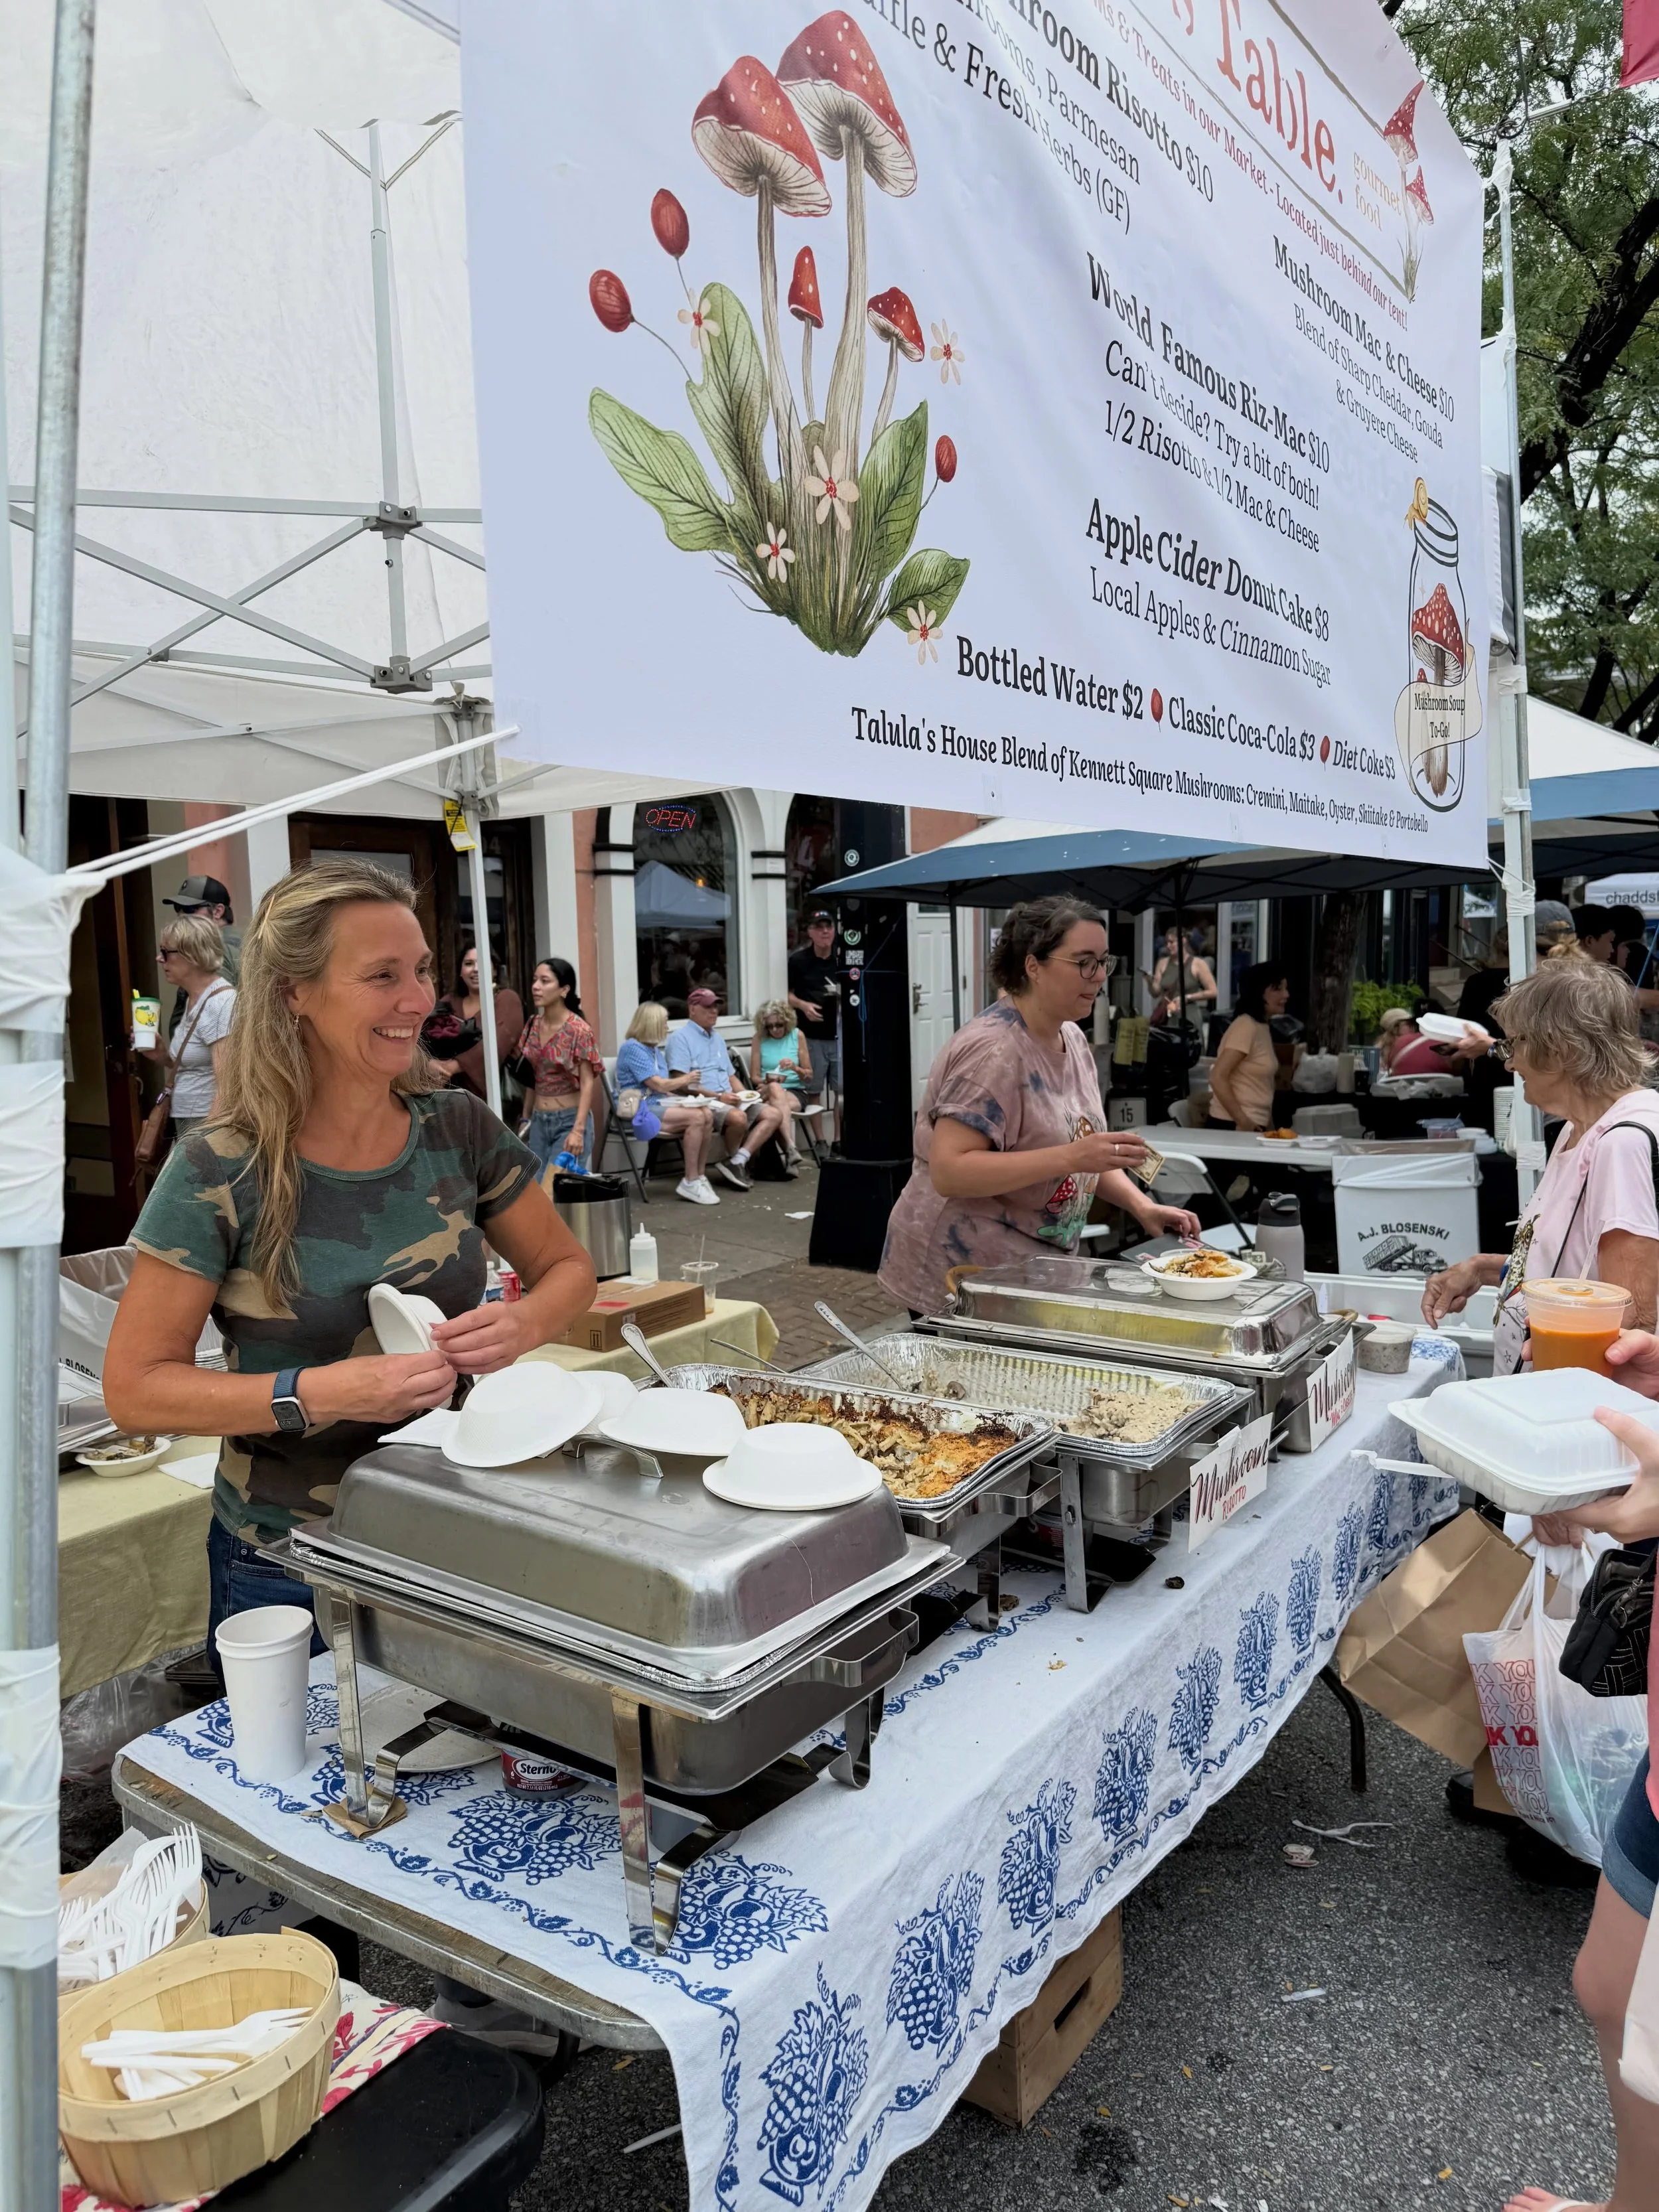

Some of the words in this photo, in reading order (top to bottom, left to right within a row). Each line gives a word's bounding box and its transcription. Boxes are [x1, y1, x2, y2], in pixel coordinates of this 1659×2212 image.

[934, 23, 956, 73] &
[964, 42, 1037, 133] Fresh
[1036, 110, 1092, 195] Herbs
[1096, 168, 1130, 236] (GF)
[1046, 67, 1141, 185] Parmesan
[1105, 56, 1183, 173] Risotto
[1186, 143, 1214, 203] $10
[1118, 11, 1128, 44] &
[1133, 27, 1181, 102] Treats
[1182, 80, 1196, 121] in
[1199, 107, 1220, 143] our
[1224, 129, 1267, 194] Market
[1276, 184, 1319, 246] Located
[1318, 226, 1340, 268] just
[1341, 244, 1372, 297] behind
[1372, 281, 1387, 310] our
[1388, 299, 1407, 331] tent!
[1354, 151, 1402, 216] gourmet
[1355, 184, 1382, 232] food
[1087, 251, 1155, 353] World
[1161, 321, 1236, 411] Famous
[1239, 380, 1307, 459] Riz-Mac
[1308, 427, 1330, 474] $10
[1273, 235, 1353, 338] Mushroom
[1354, 313, 1382, 363] Mac
[1386, 342, 1396, 374] &
[1398, 352, 1438, 409] Cheese
[1439, 385, 1455, 423] $10
[1294, 303, 1327, 354] Blend
[1329, 338, 1341, 366] of
[1341, 348, 1371, 396] Sharp
[1372, 372, 1415, 432] Cheddar,
[1415, 410, 1443, 449] Gouda
[1105, 399, 1136, 456] 1/2
[1137, 415, 1202, 481] Risotto
[1202, 458, 1214, 488] &
[1213, 466, 1233, 504] 1/2
[1235, 479, 1264, 524] Mac
[1265, 500, 1277, 528] &
[1278, 505, 1320, 553] Cheese
[1106, 339, 1160, 402] Can't
[1159, 376, 1211, 441] decide?
[1214, 417, 1241, 467] Try
[1244, 445, 1251, 469] a
[1252, 441, 1271, 481] bit
[1273, 456, 1287, 486] of
[1287, 464, 1320, 511] both!
[1335, 378, 1345, 404] &
[1346, 390, 1387, 444] Gruyere
[1386, 421, 1418, 464] Cheese
[1085, 497, 1153, 565] Apple
[1157, 531, 1222, 590] Cider
[1224, 556, 1278, 617] Donut
[1278, 587, 1313, 635] Cake
[1314, 603, 1330, 642] $8
[1090, 565, 1141, 618] Local
[1143, 589, 1200, 640] Apples
[1202, 612, 1217, 646] &
[1220, 618, 1301, 674] Cinnamon
[1301, 648, 1332, 688] Sugar
[956, 635, 1047, 697] Bottled
[1050, 662, 1119, 714] Water
[1122, 679, 1144, 721] $2
[1168, 696, 1225, 741] Classic
[1227, 713, 1297, 759] Coca-Cola
[1299, 729, 1315, 762] $3
[1333, 739, 1359, 771] Diet
[1360, 747, 1385, 778] Coke
[1386, 755, 1396, 781] $3
[1414, 692, 1449, 711] Mushroom
[1449, 694, 1465, 716] Soup
[1429, 721, 1451, 739] To-Go!
[646, 808, 697, 829] OPEN
[851, 706, 936, 753] Talula's
[940, 723, 997, 764] House
[1001, 735, 1048, 773] Blend
[1050, 745, 1067, 782] of
[1068, 749, 1126, 785] Kennett
[1129, 761, 1173, 796] Square
[1175, 770, 1245, 806] Mushrooms:
[1246, 783, 1288, 818] Cremini,
[1289, 791, 1328, 822] Maitake,
[1329, 798, 1358, 826] Oyster,
[1358, 804, 1389, 828] Shiitake
[1389, 811, 1395, 828] &
[1396, 810, 1429, 834] Portobello
[1120, 1108, 1133, 1123] 15
[1357, 1226, 1379, 1242] A.J.
[1380, 1222, 1451, 1240] BLOSENSKI
[1222, 1484, 1247, 1521] RISOTTO
[520, 1763, 557, 1775] Sterno
